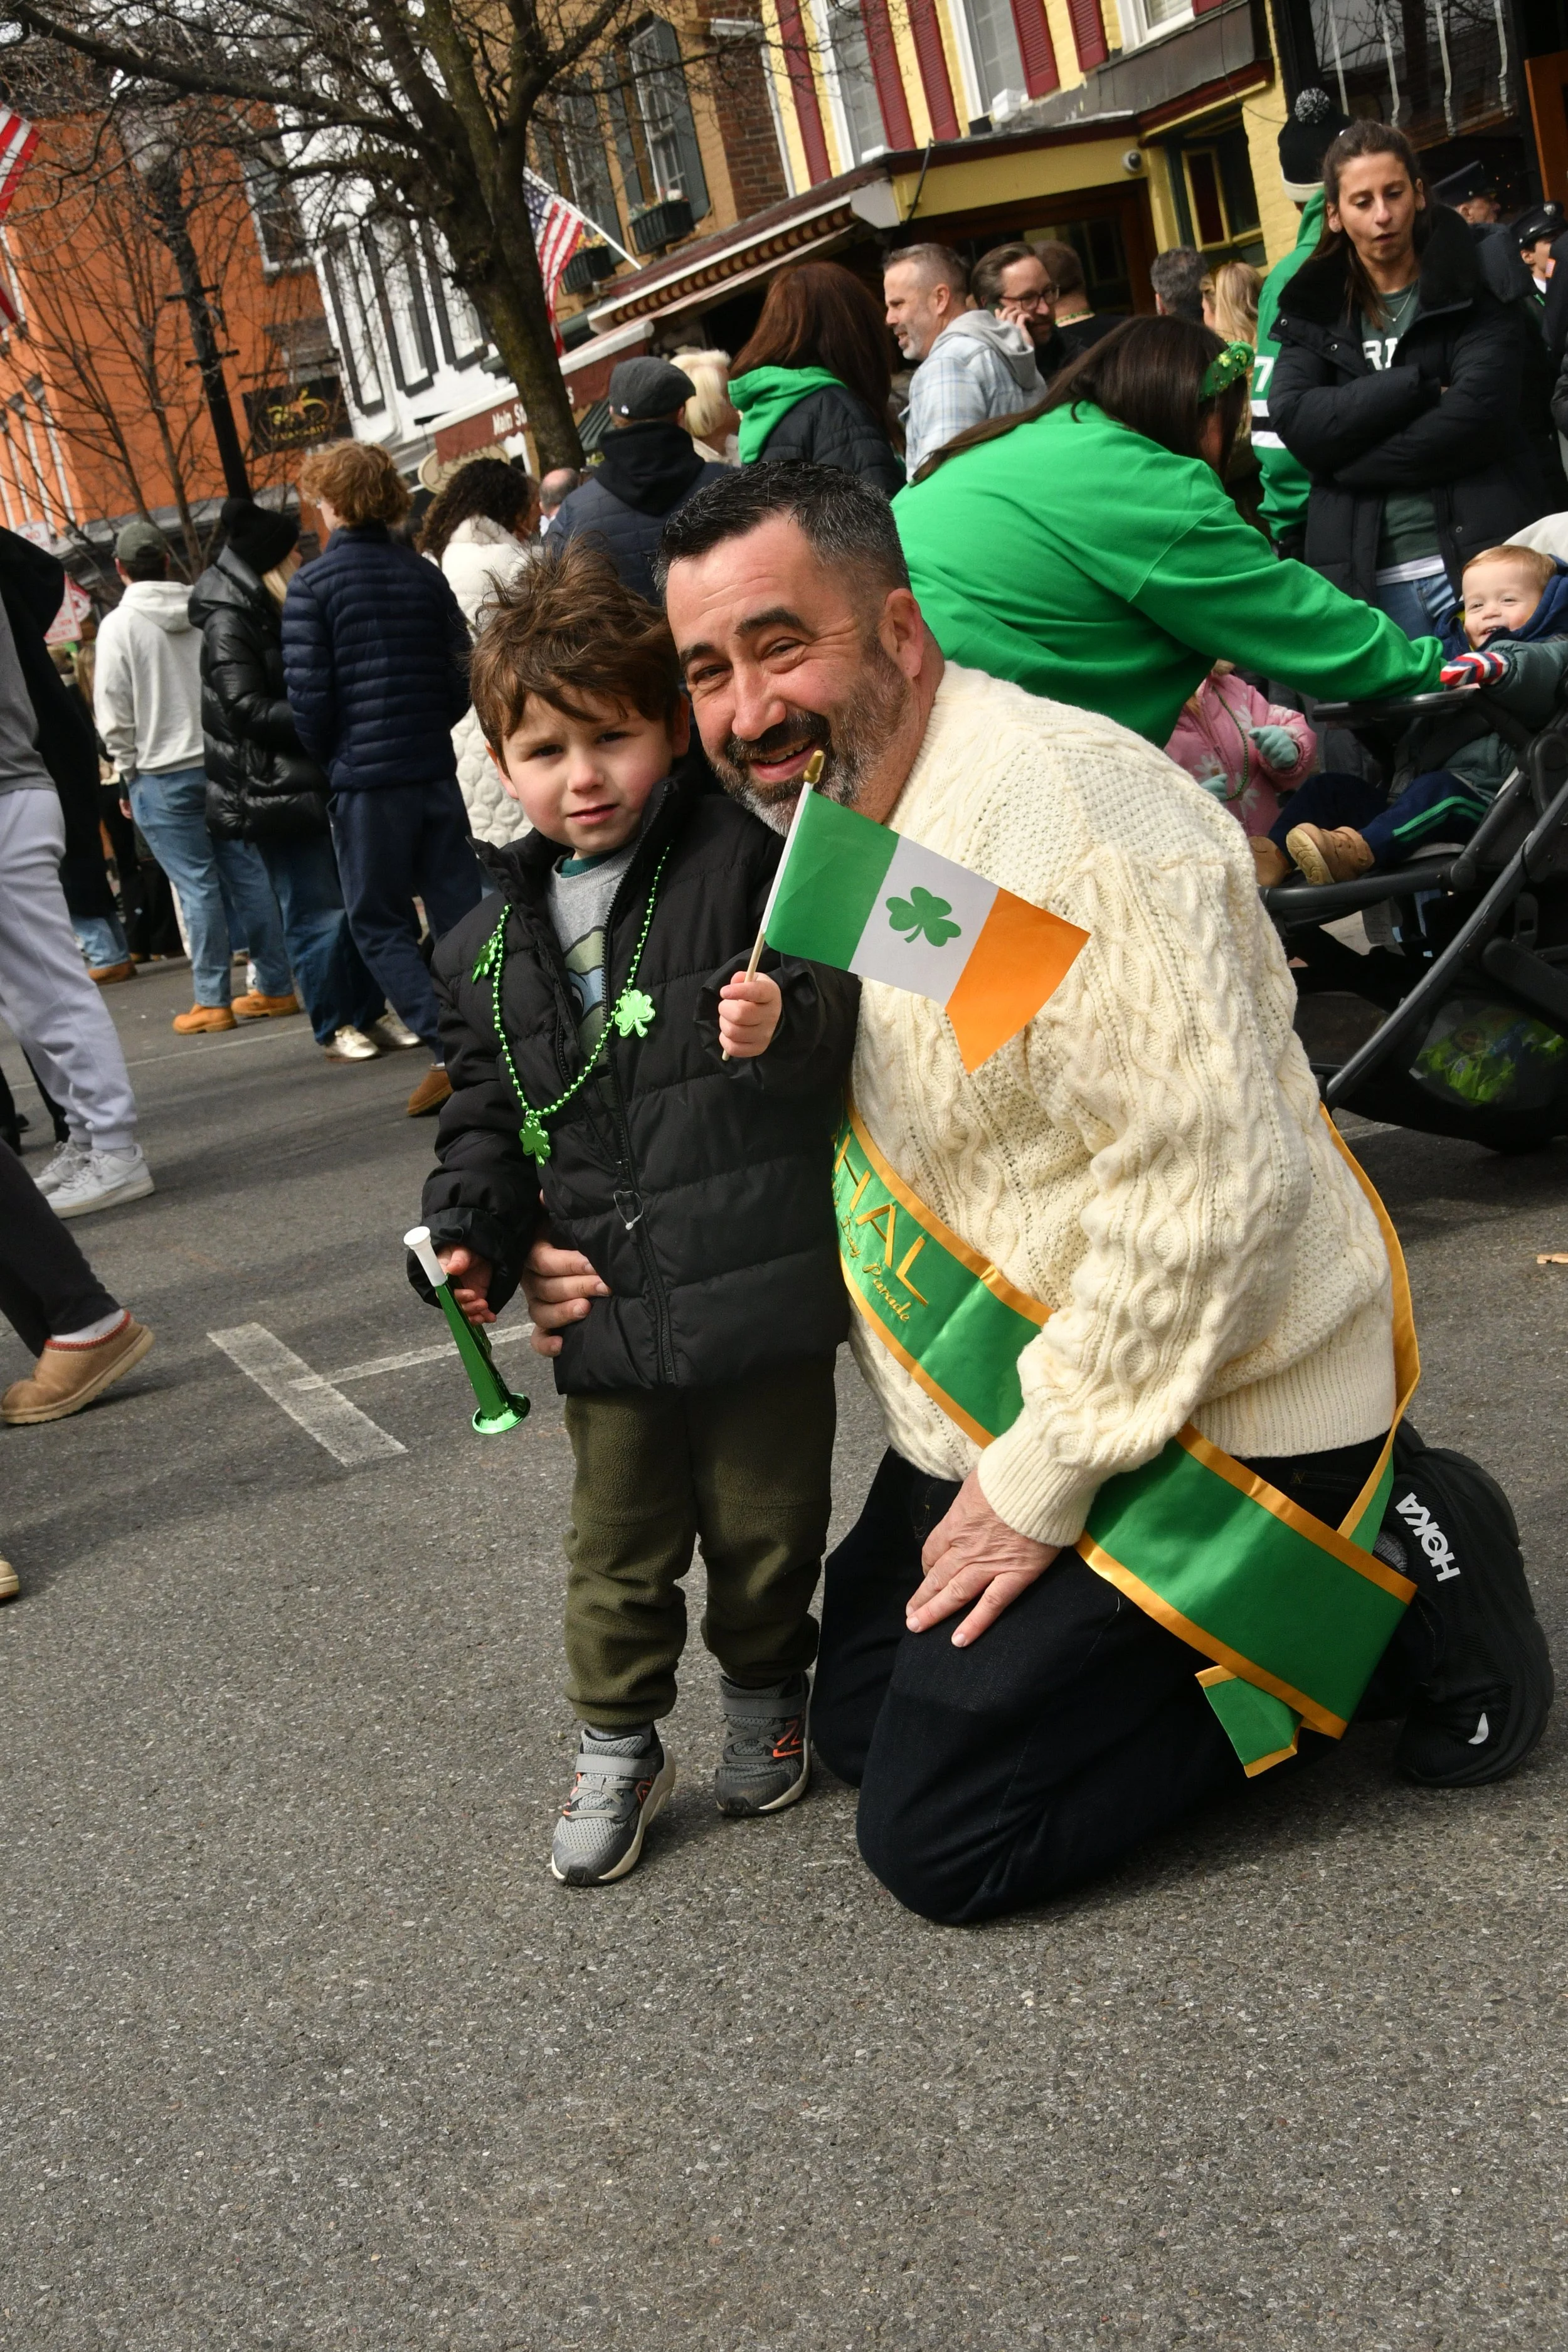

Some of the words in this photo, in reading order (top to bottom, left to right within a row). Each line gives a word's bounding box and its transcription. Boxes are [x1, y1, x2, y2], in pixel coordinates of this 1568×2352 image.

[1254, 356, 1274, 393] 7
[492, 410, 513, 435] Main
[840, 1215, 861, 1258] Day
[862, 1263, 911, 1322] Parade
[1395, 1492, 1461, 1582] HOKA
